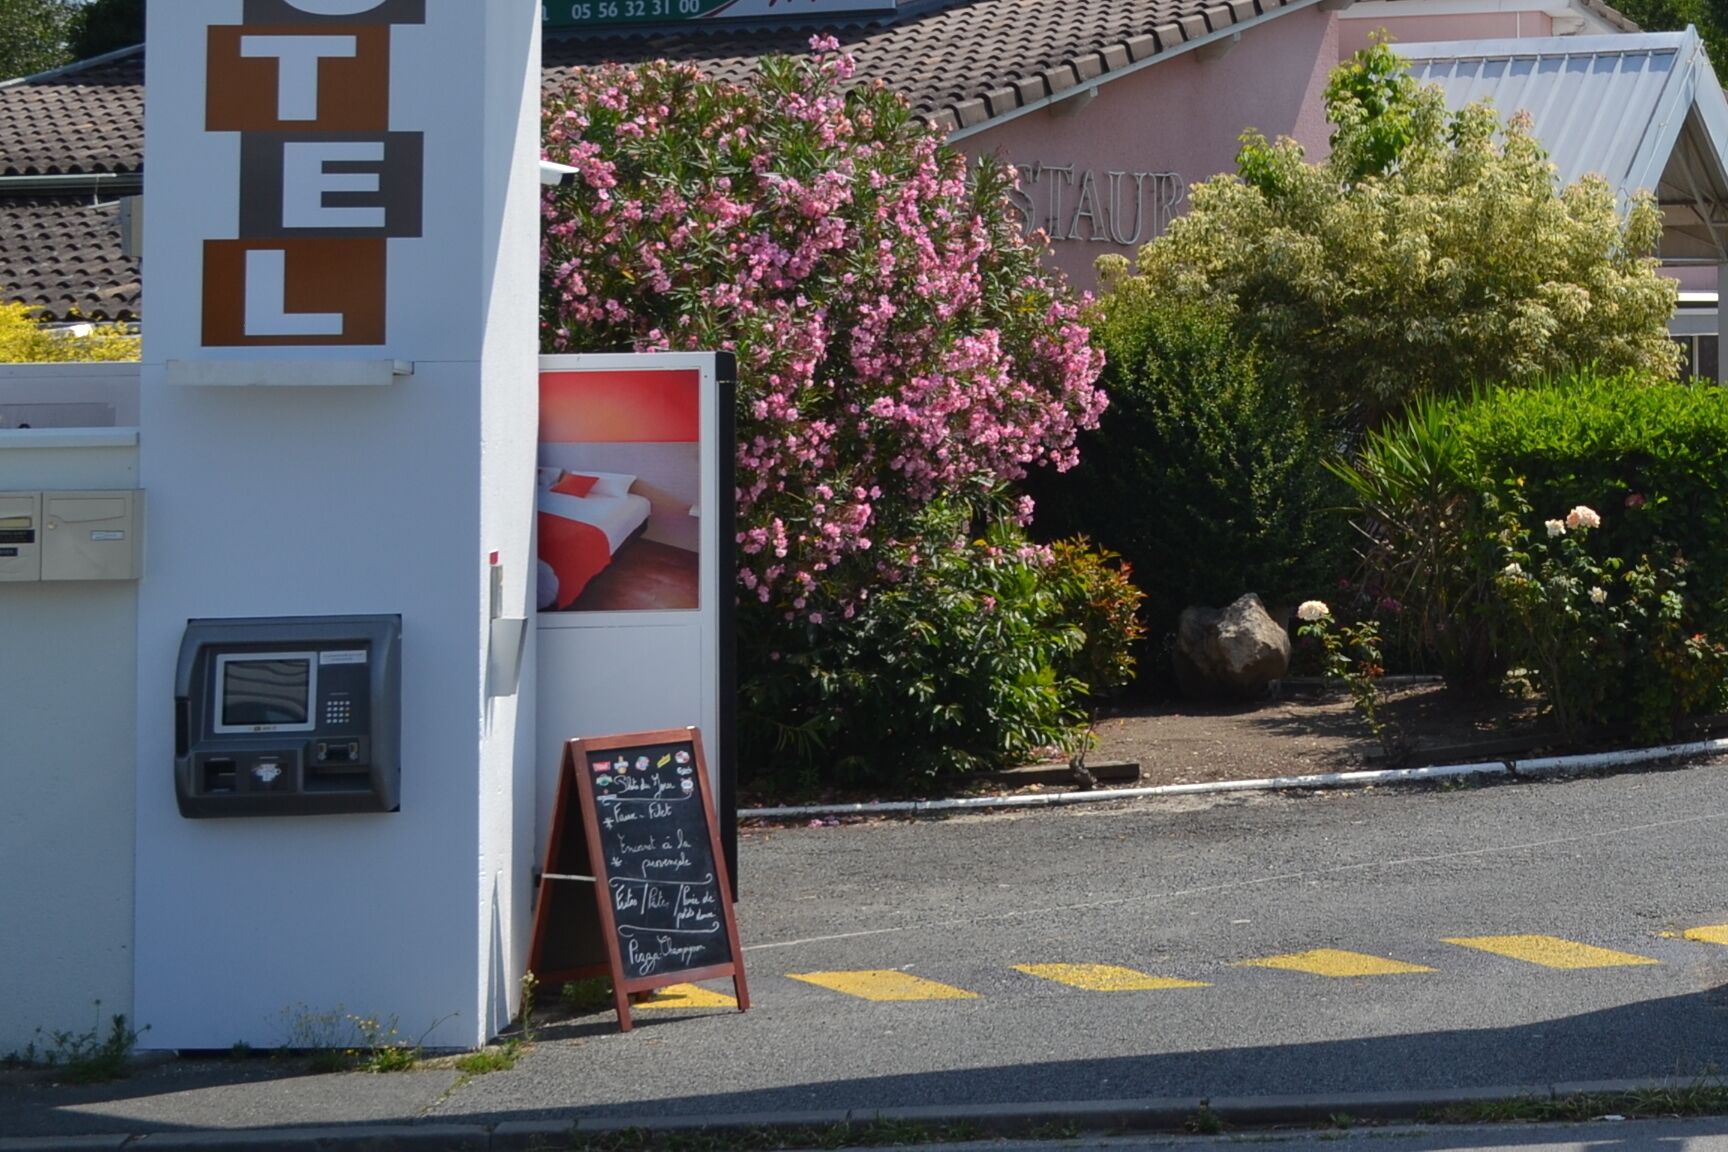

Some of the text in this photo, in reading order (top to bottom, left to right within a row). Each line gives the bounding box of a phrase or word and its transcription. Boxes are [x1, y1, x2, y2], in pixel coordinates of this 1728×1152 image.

[571, 3, 592, 20] 05
[598, 1, 619, 18] 56
[624, 0, 646, 17] 32
[651, 0, 671, 16] 31
